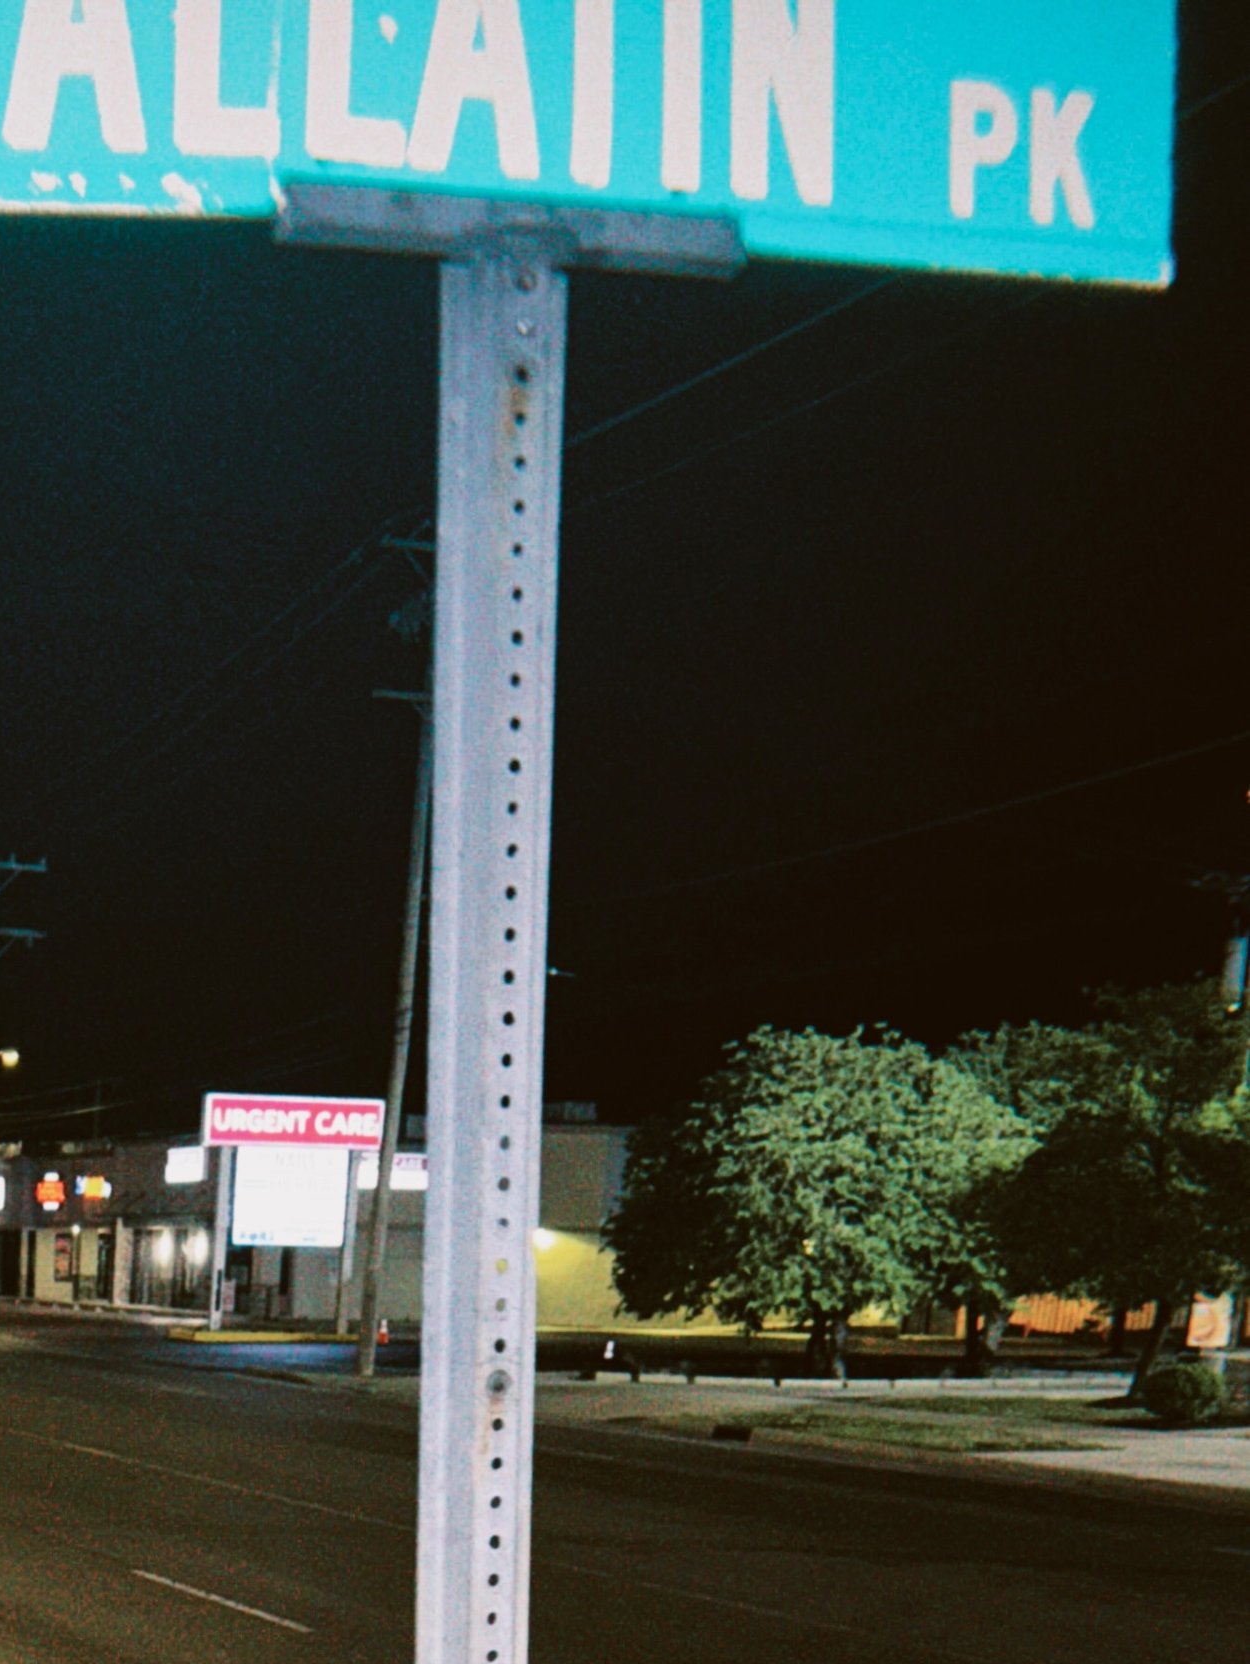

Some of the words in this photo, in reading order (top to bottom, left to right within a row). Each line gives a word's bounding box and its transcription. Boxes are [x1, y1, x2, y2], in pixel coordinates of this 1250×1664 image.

[949, 78, 1096, 229] PK
[213, 1107, 310, 1134] URGENT
[315, 1111, 380, 1137] CARE
